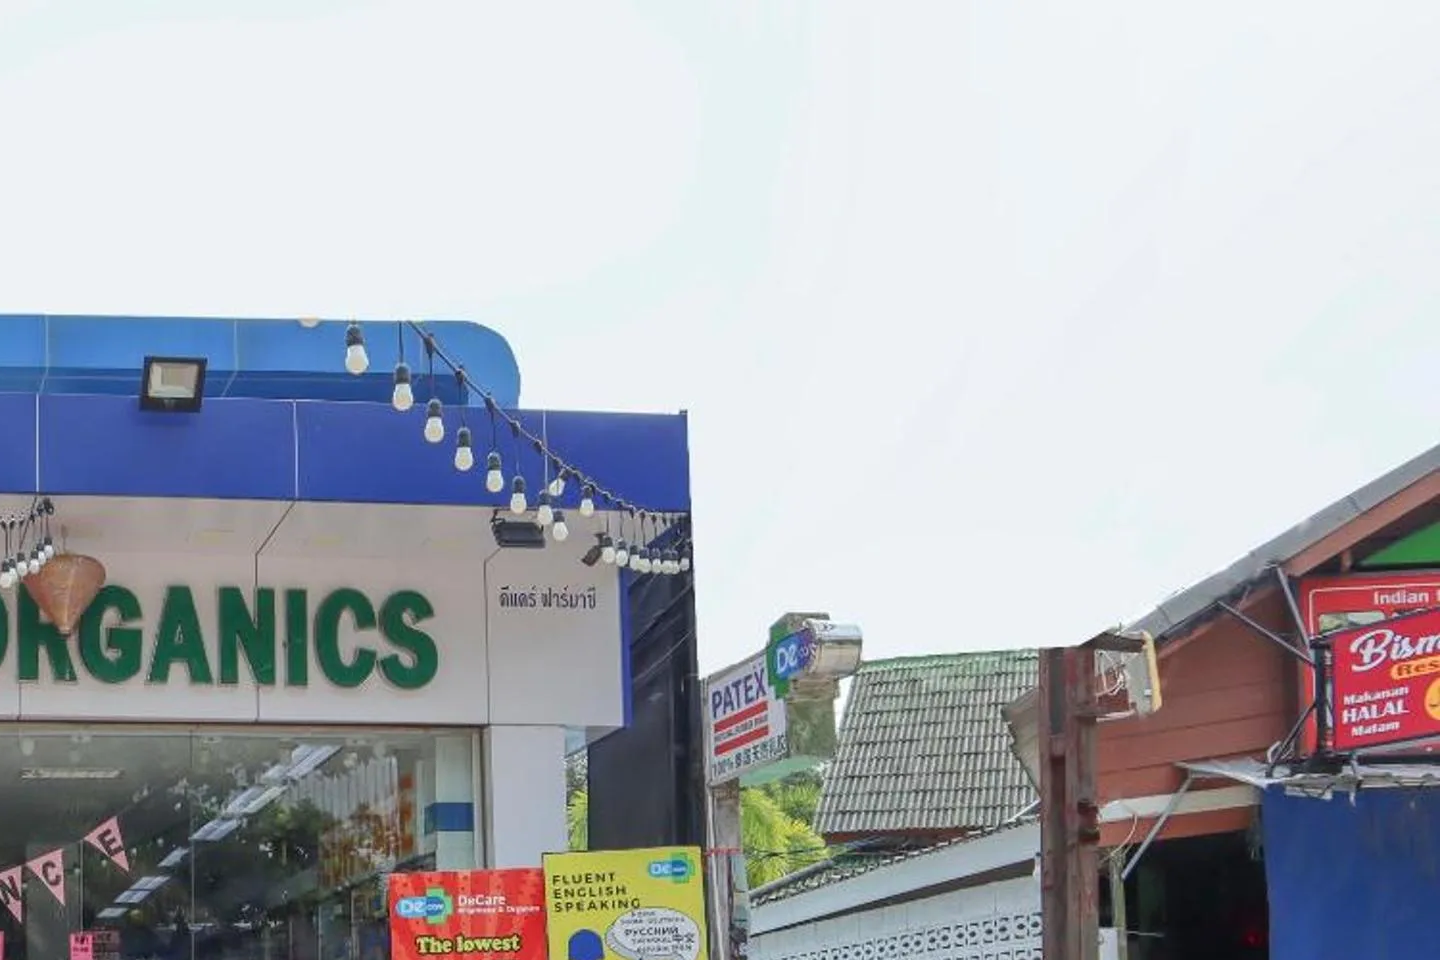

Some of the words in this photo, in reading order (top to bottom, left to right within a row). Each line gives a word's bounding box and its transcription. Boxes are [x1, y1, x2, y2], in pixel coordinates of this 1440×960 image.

[1374, 590, 1429, 605] Indian
[711, 667, 767, 719] PATEX
[1341, 700, 1410, 724] HALAL
[552, 872, 616, 885] FLUENT
[553, 886, 627, 899] ENGLISH
[554, 898, 640, 913] SPEAKING
[417, 935, 453, 953] The
[456, 933, 521, 953] lowest
